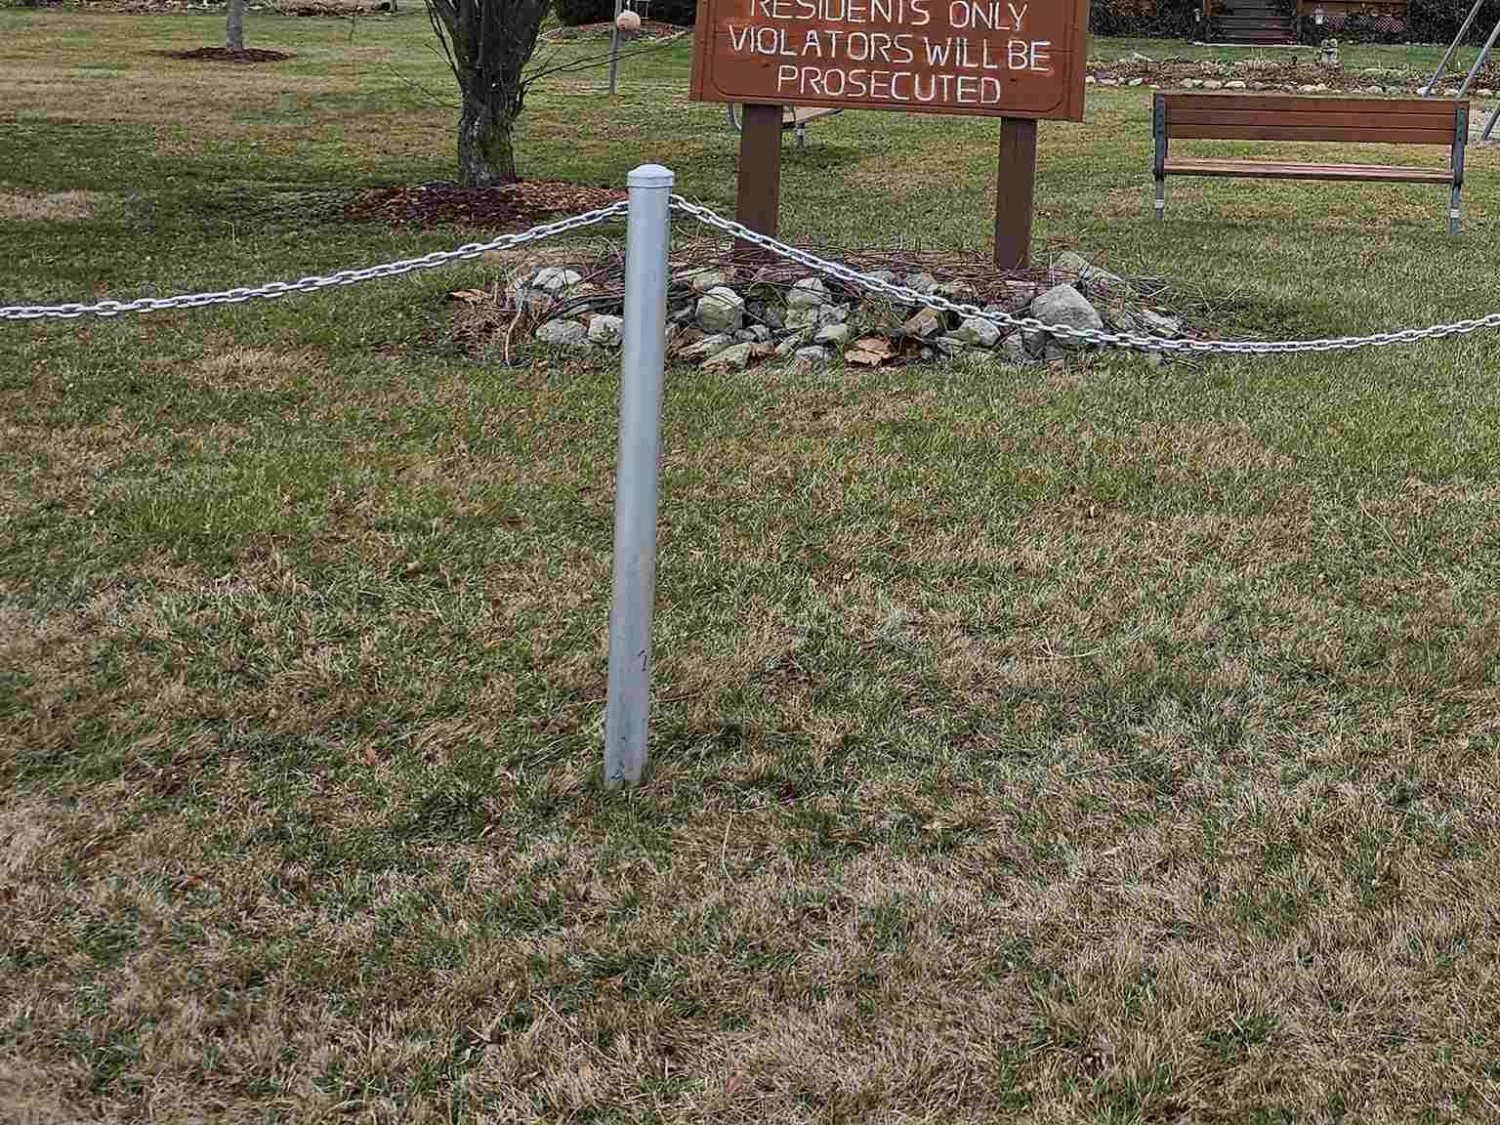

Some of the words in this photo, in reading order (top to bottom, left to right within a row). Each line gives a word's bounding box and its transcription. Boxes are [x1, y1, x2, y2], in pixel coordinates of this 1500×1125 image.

[949, 0, 1028, 31] ONLY
[729, 26, 913, 64] VIOLATORS
[923, 37, 997, 70] WILL
[1008, 40, 1051, 71] BE
[777, 65, 1000, 104] PROSECUTED
